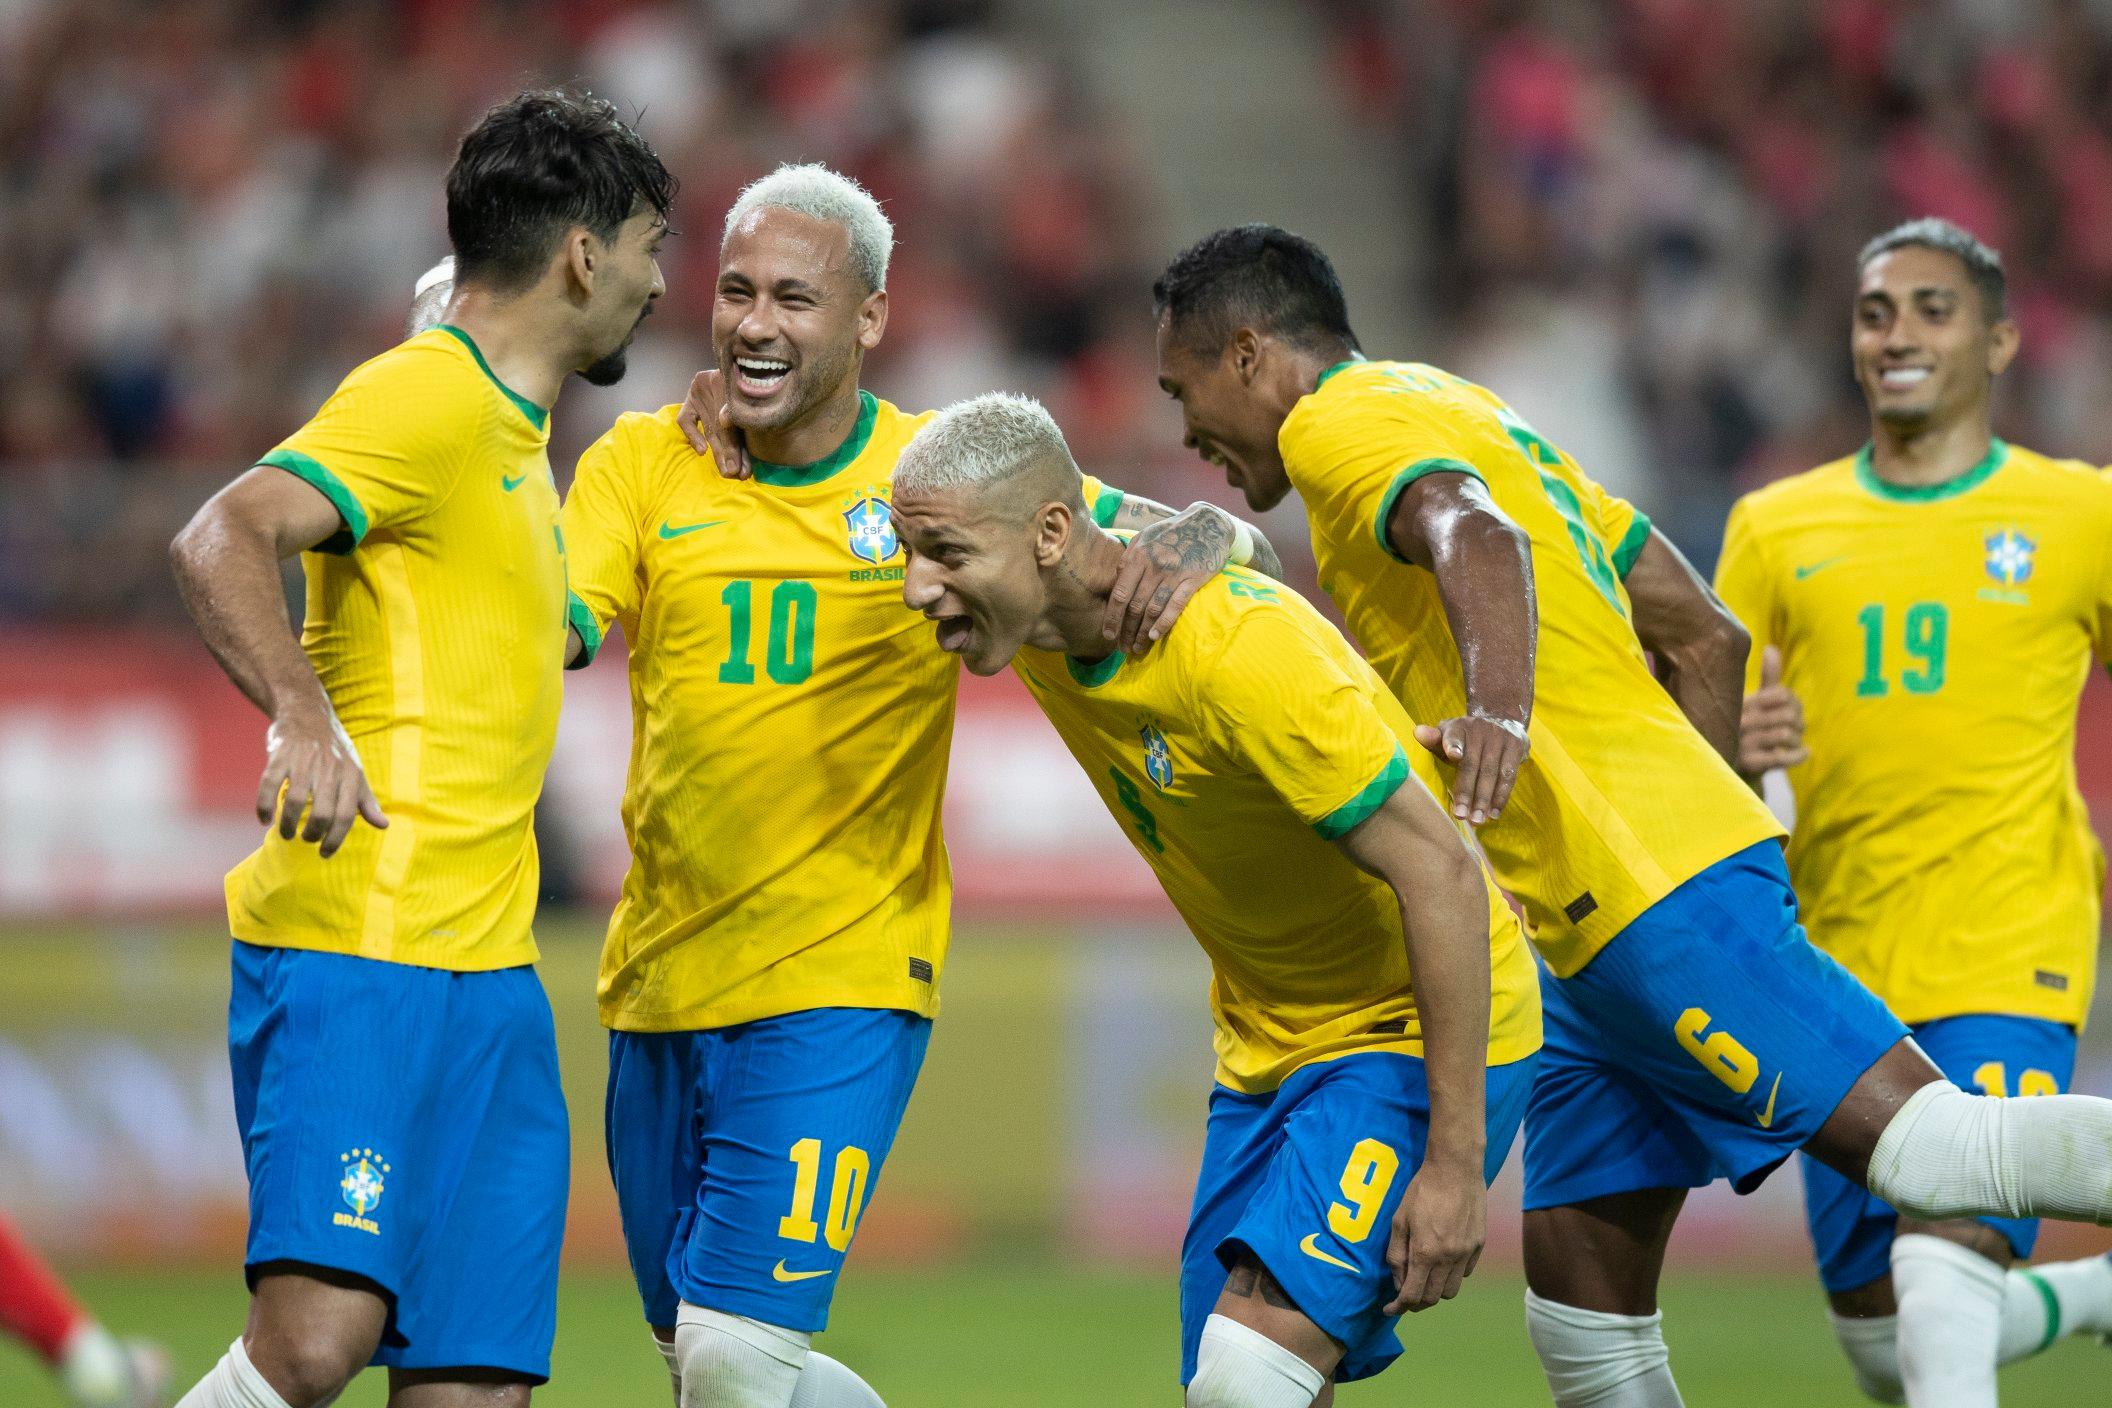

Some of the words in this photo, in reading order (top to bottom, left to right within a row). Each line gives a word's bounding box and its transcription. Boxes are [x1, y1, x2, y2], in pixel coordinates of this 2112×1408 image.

[849, 567, 906, 582] BRASIL
[718, 579, 818, 685] 10
[1856, 602, 1948, 698] 19
[1674, 1007, 1760, 1095] 6
[333, 1212, 380, 1236] BRASIL
[778, 1137, 870, 1252] 10
[1327, 1138, 1400, 1243] 9
